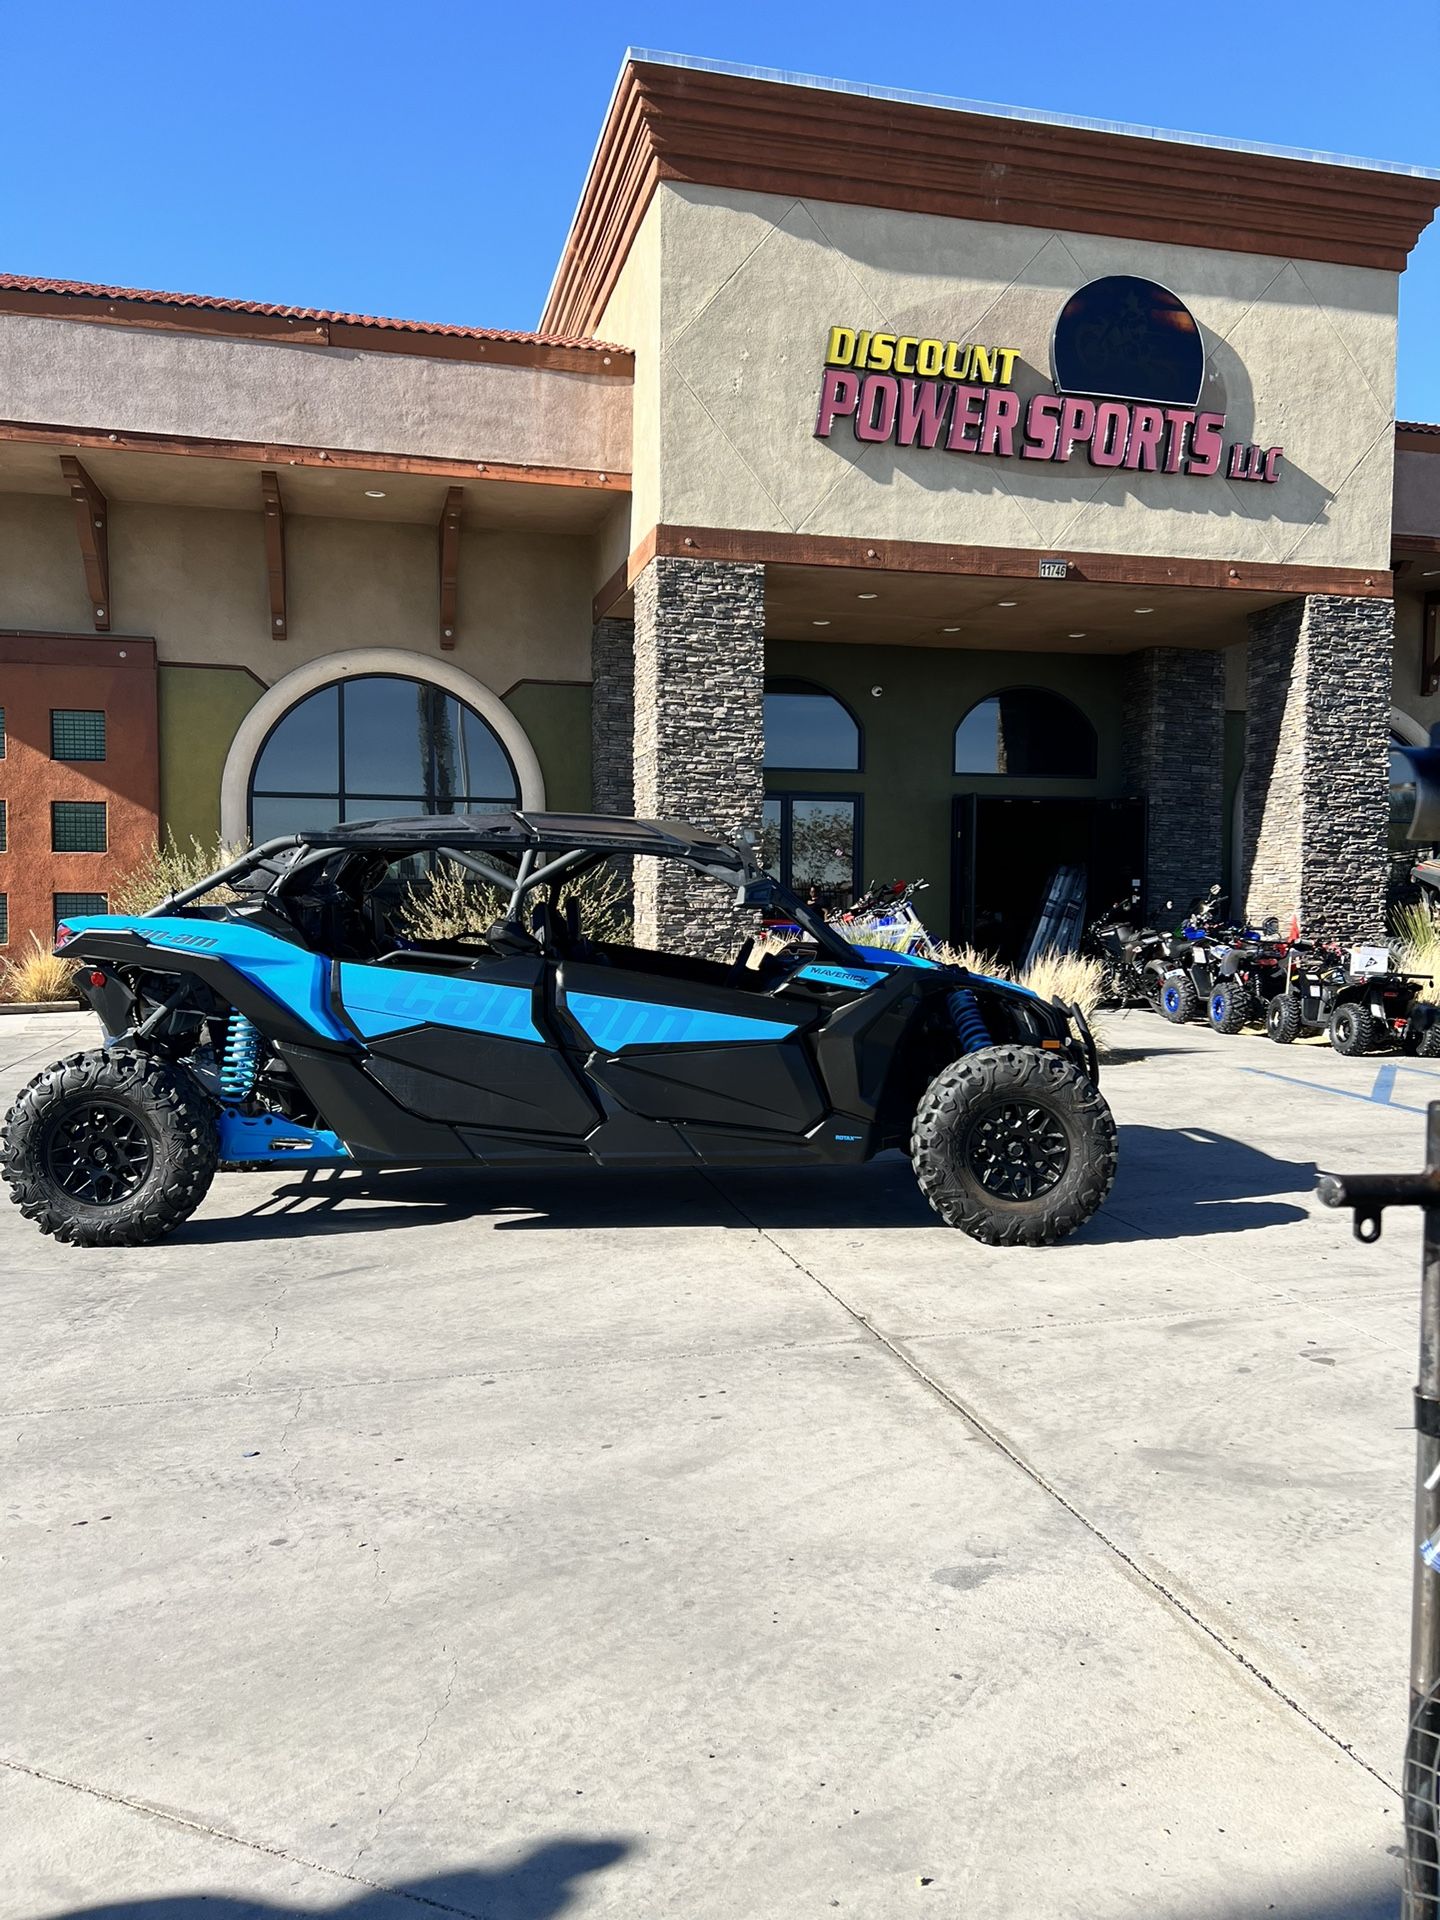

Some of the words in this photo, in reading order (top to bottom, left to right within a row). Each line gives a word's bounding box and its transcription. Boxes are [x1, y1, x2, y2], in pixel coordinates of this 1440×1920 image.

[825, 326, 1020, 386] DISCOUNT
[1226, 443, 1285, 483] LLC
[1041, 565, 1065, 576] 11746
[124, 927, 218, 948] an-am
[810, 967, 869, 982] MAVERICK
